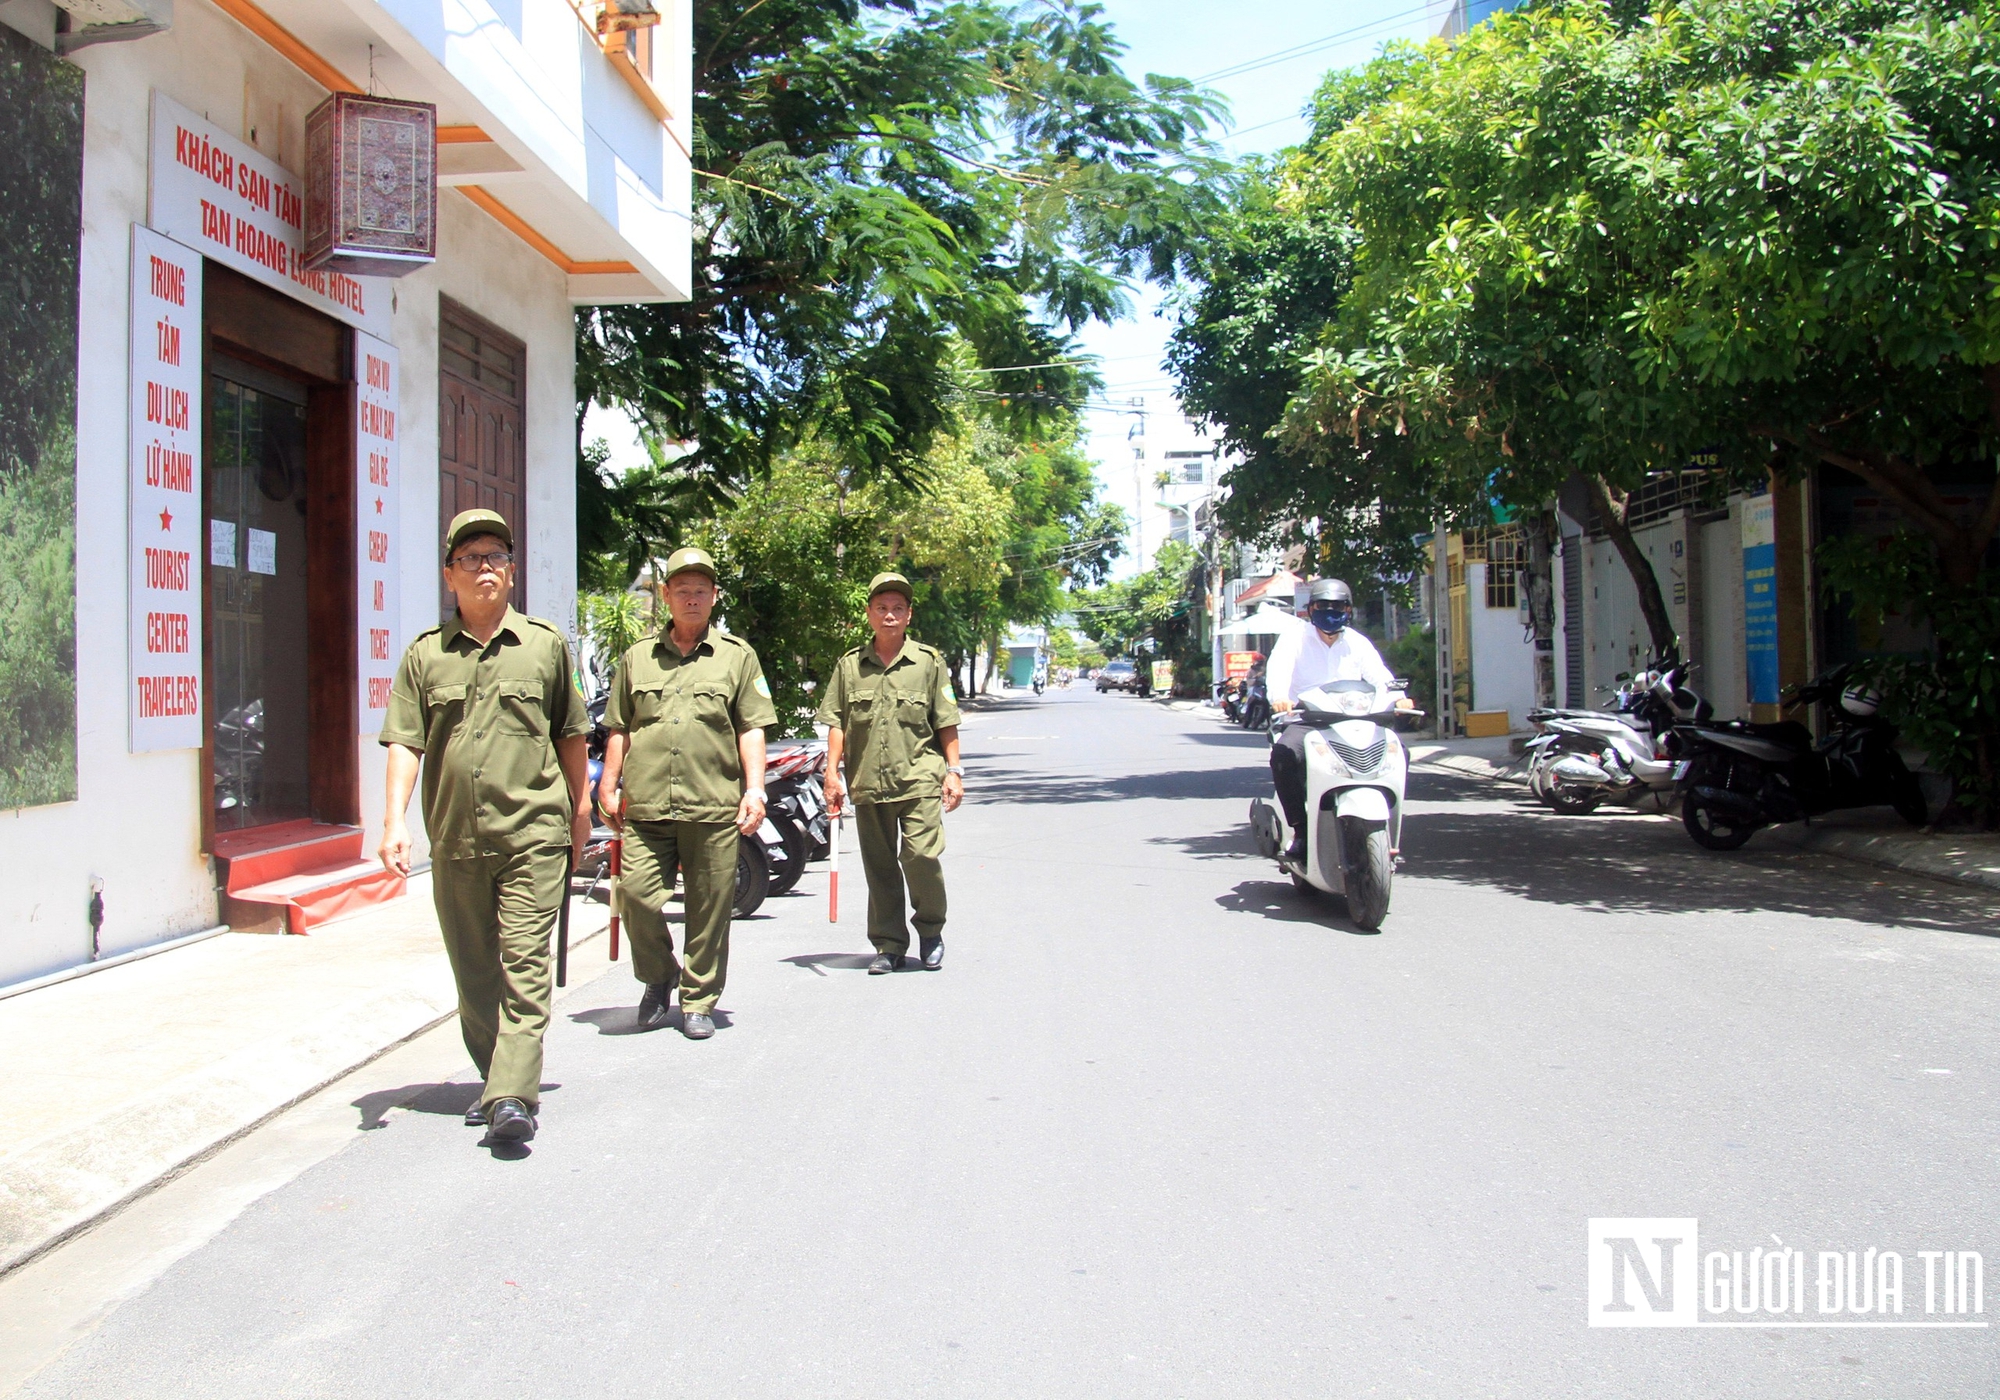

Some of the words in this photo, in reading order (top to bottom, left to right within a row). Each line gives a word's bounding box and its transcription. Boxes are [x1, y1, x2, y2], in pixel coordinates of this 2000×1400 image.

[176, 125, 234, 191] KHÁCH
[238, 163, 270, 212] SẠN
[274, 182, 302, 230] TÂN
[201, 199, 231, 248] TAN
[236, 218, 287, 276] HOANG
[329, 271, 365, 316] HOTEL
[150, 254, 185, 308] TRUNG
[157, 315, 181, 367] TÂM
[147, 380, 162, 423] DU
[165, 389, 189, 437] LỊCH
[369, 399, 382, 438] MÁY
[383, 408, 395, 442] BAY
[162, 441, 192, 494] HÀNH
[369, 447, 380, 486] GIÁ
[368, 529, 388, 564] CHEAP
[145, 547, 190, 592] TOURIST
[373, 579, 384, 611] AIR
[147, 611, 189, 654] CENTER
[370, 628, 389, 660] TICKET
[137, 675, 197, 718] TRAVELERS
